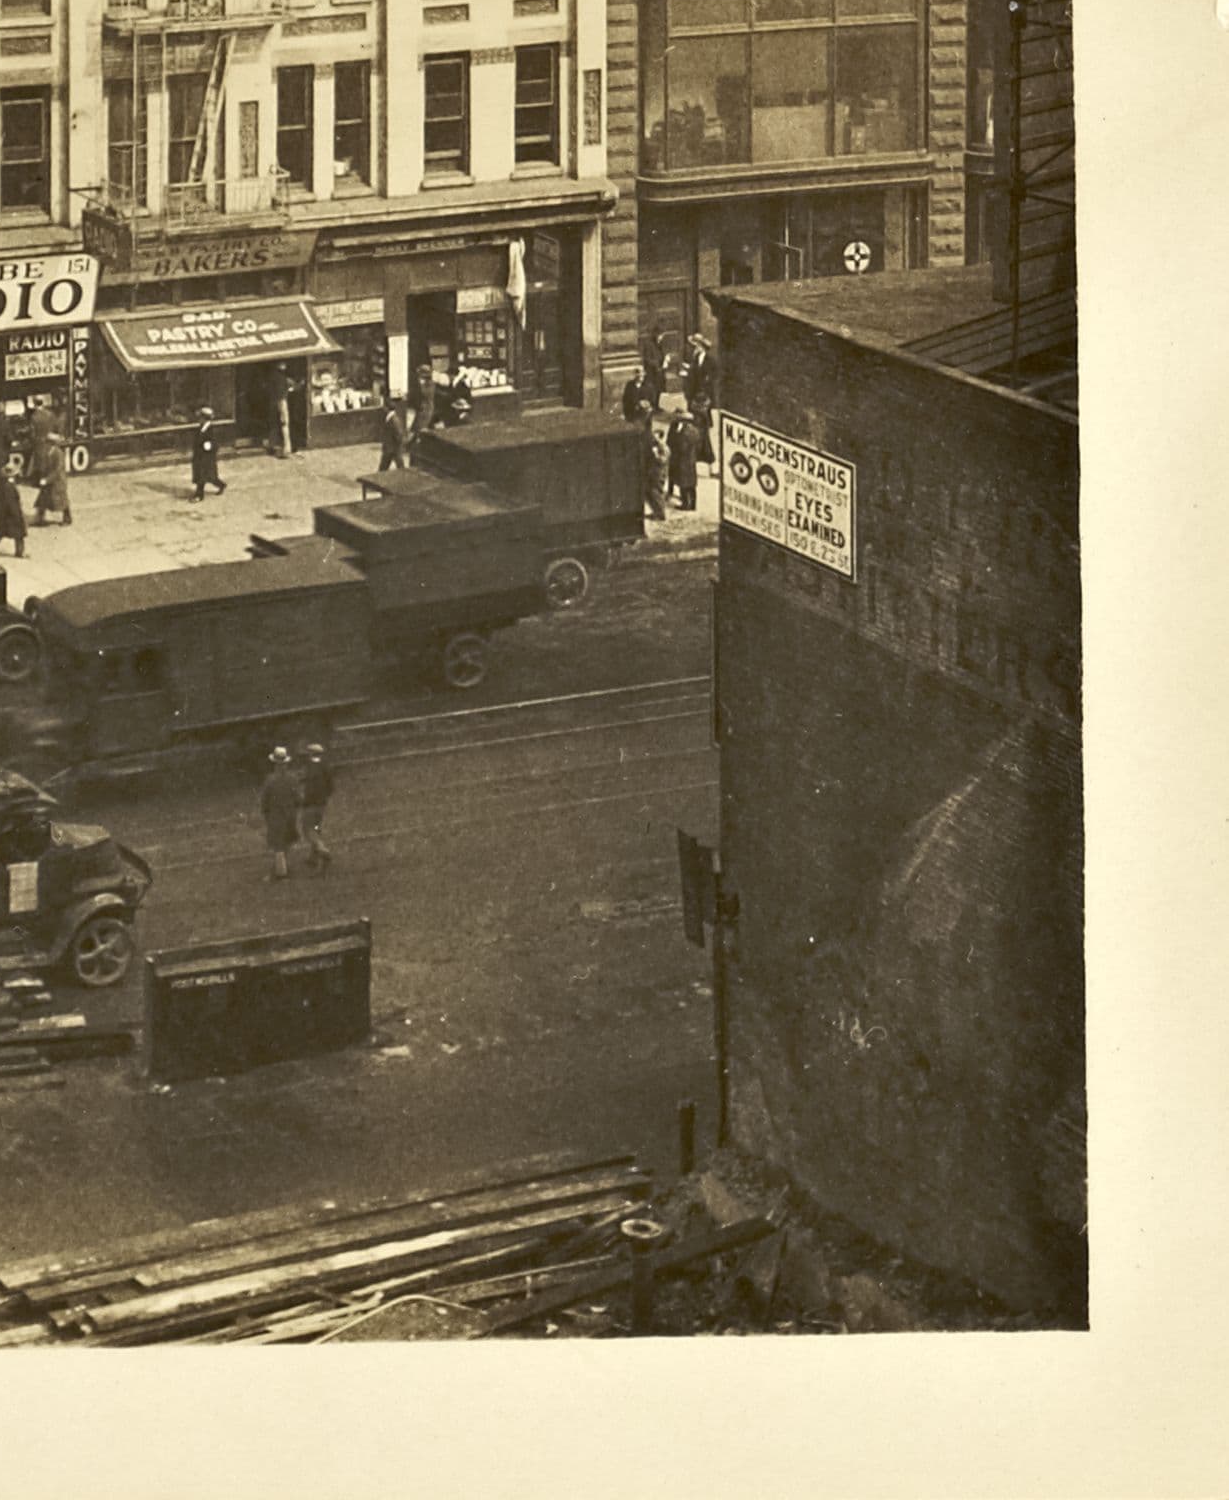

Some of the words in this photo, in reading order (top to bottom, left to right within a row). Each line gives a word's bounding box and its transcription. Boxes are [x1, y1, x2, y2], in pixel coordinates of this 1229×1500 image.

[67, 258, 90, 273] 151
[153, 249, 270, 278] BAKERS
[9, 331, 65, 352] RADIO
[146, 323, 224, 343] PASTRY
[74, 341, 88, 438] PAYMENTS
[784, 470, 849, 510] OPTOMETRIST
[795, 492, 834, 523] EYES
[788, 510, 846, 549] EXAMINED
[790, 531, 808, 550] 150
